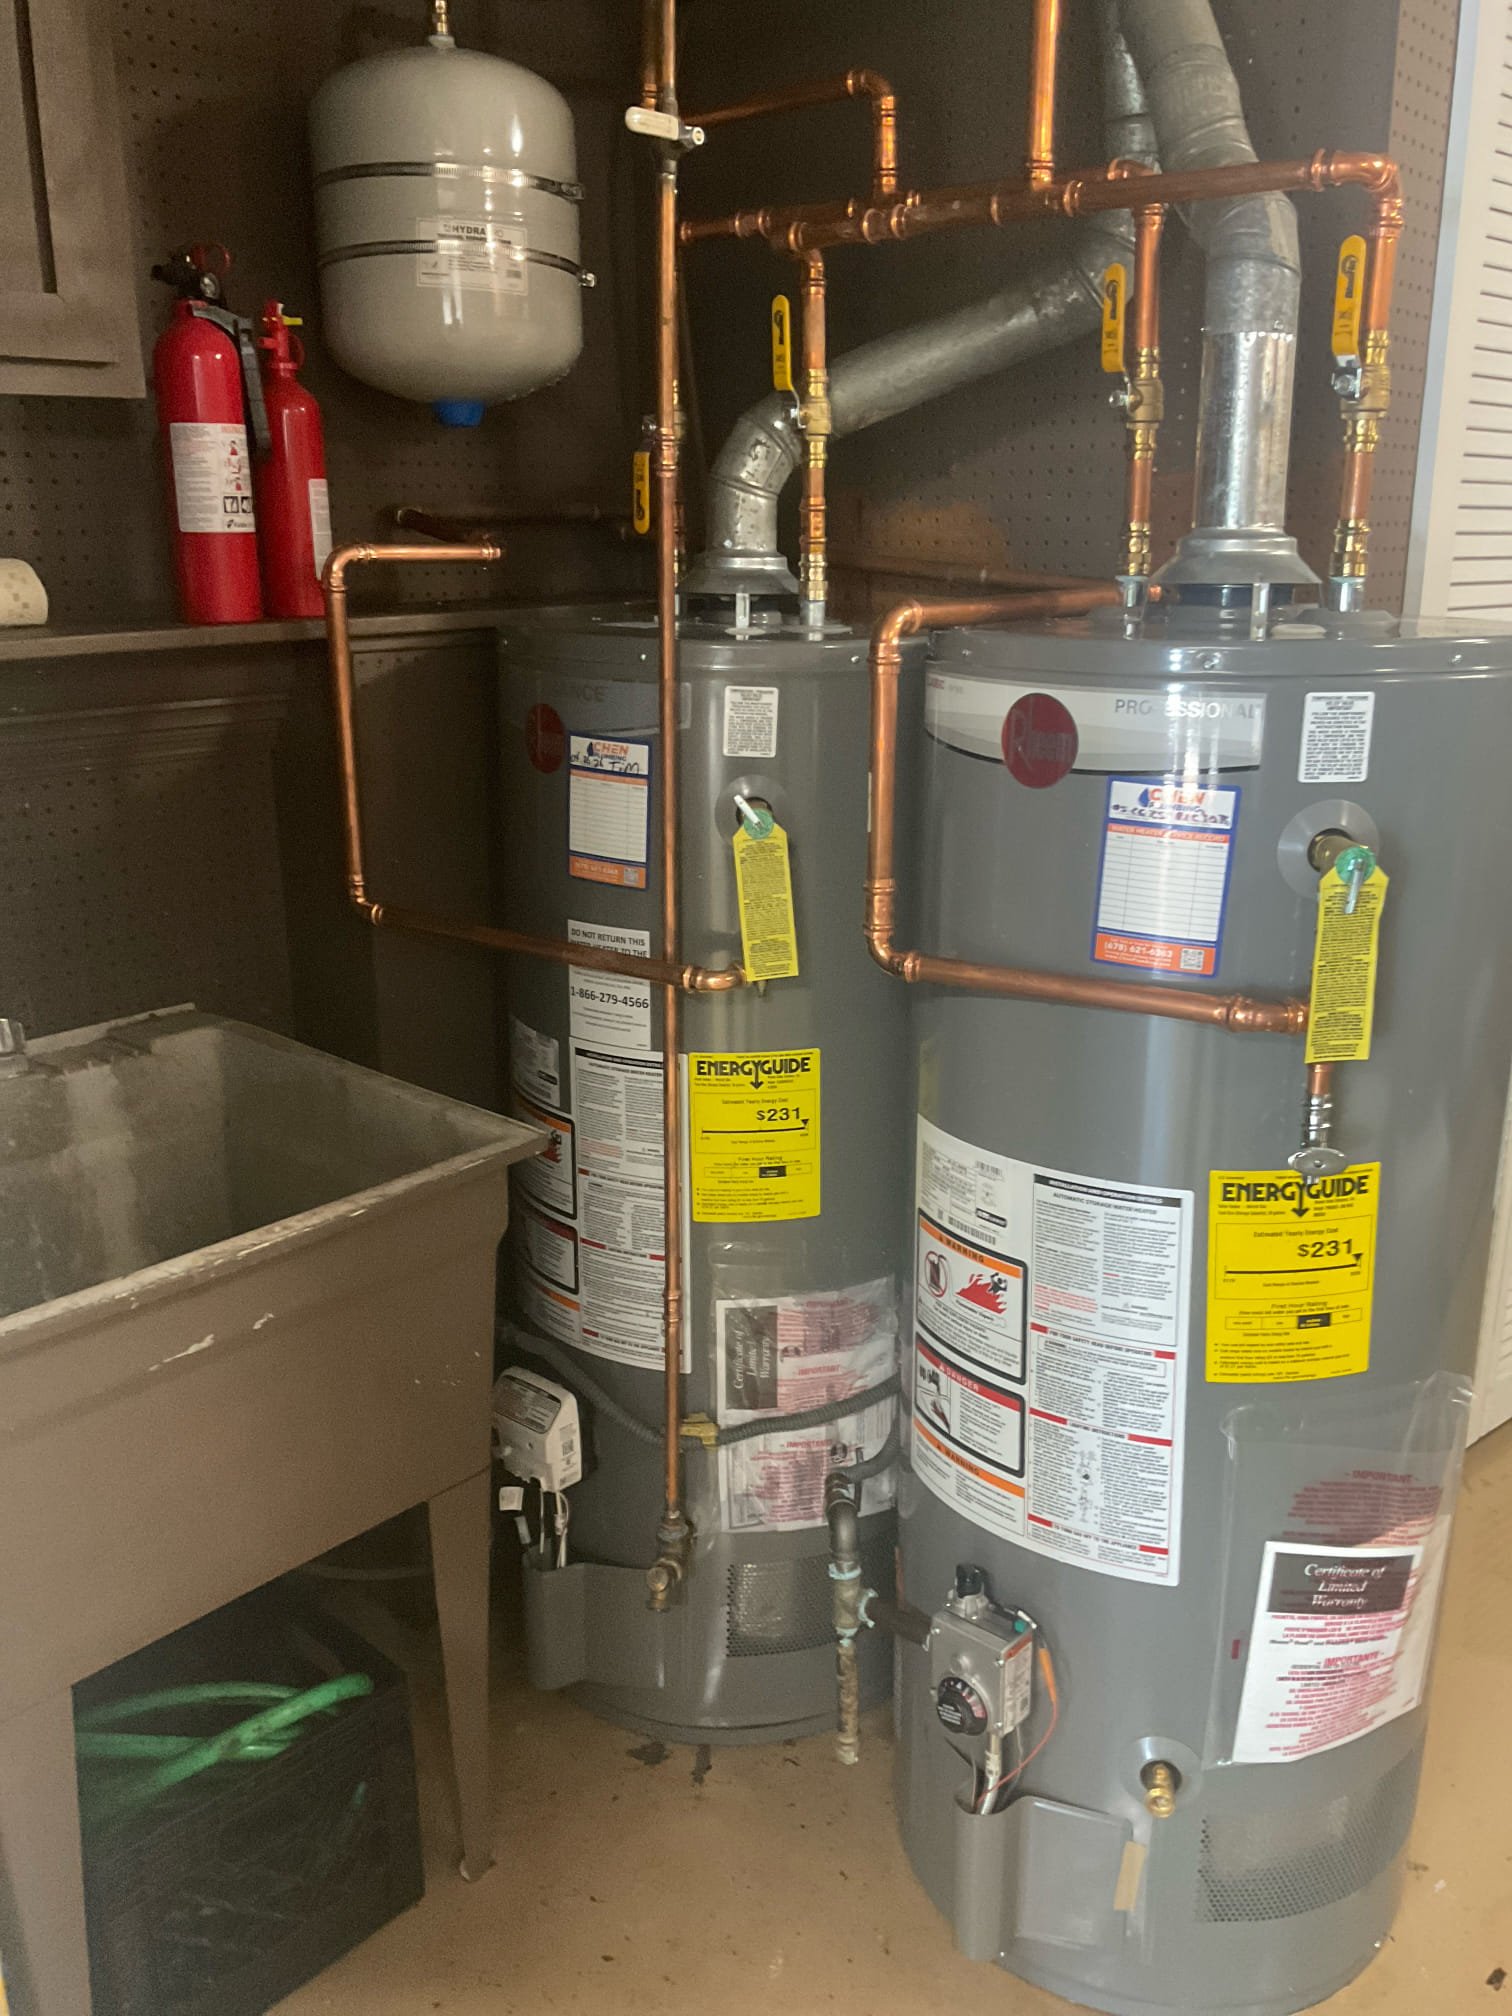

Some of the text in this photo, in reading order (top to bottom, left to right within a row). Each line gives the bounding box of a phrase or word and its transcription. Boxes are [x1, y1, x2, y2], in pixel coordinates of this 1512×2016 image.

[1114, 699, 1258, 720] PROESSIONAL
[593, 742, 629, 755] CHEN
[571, 928, 646, 946] DO NOT RETURN THIS
[570, 985, 649, 1009] 1-866-279-4566
[696, 1056, 811, 1077] ENERGYGUIDE
[756, 1107, 800, 1122] $231
[1222, 1175, 1370, 1203] ENERGYGUIDE
[946, 1237, 984, 1263] WARNING
[1297, 1239, 1353, 1258] $231
[946, 1366, 980, 1392] DANGER
[1303, 1563, 1387, 1580] Certificate of
